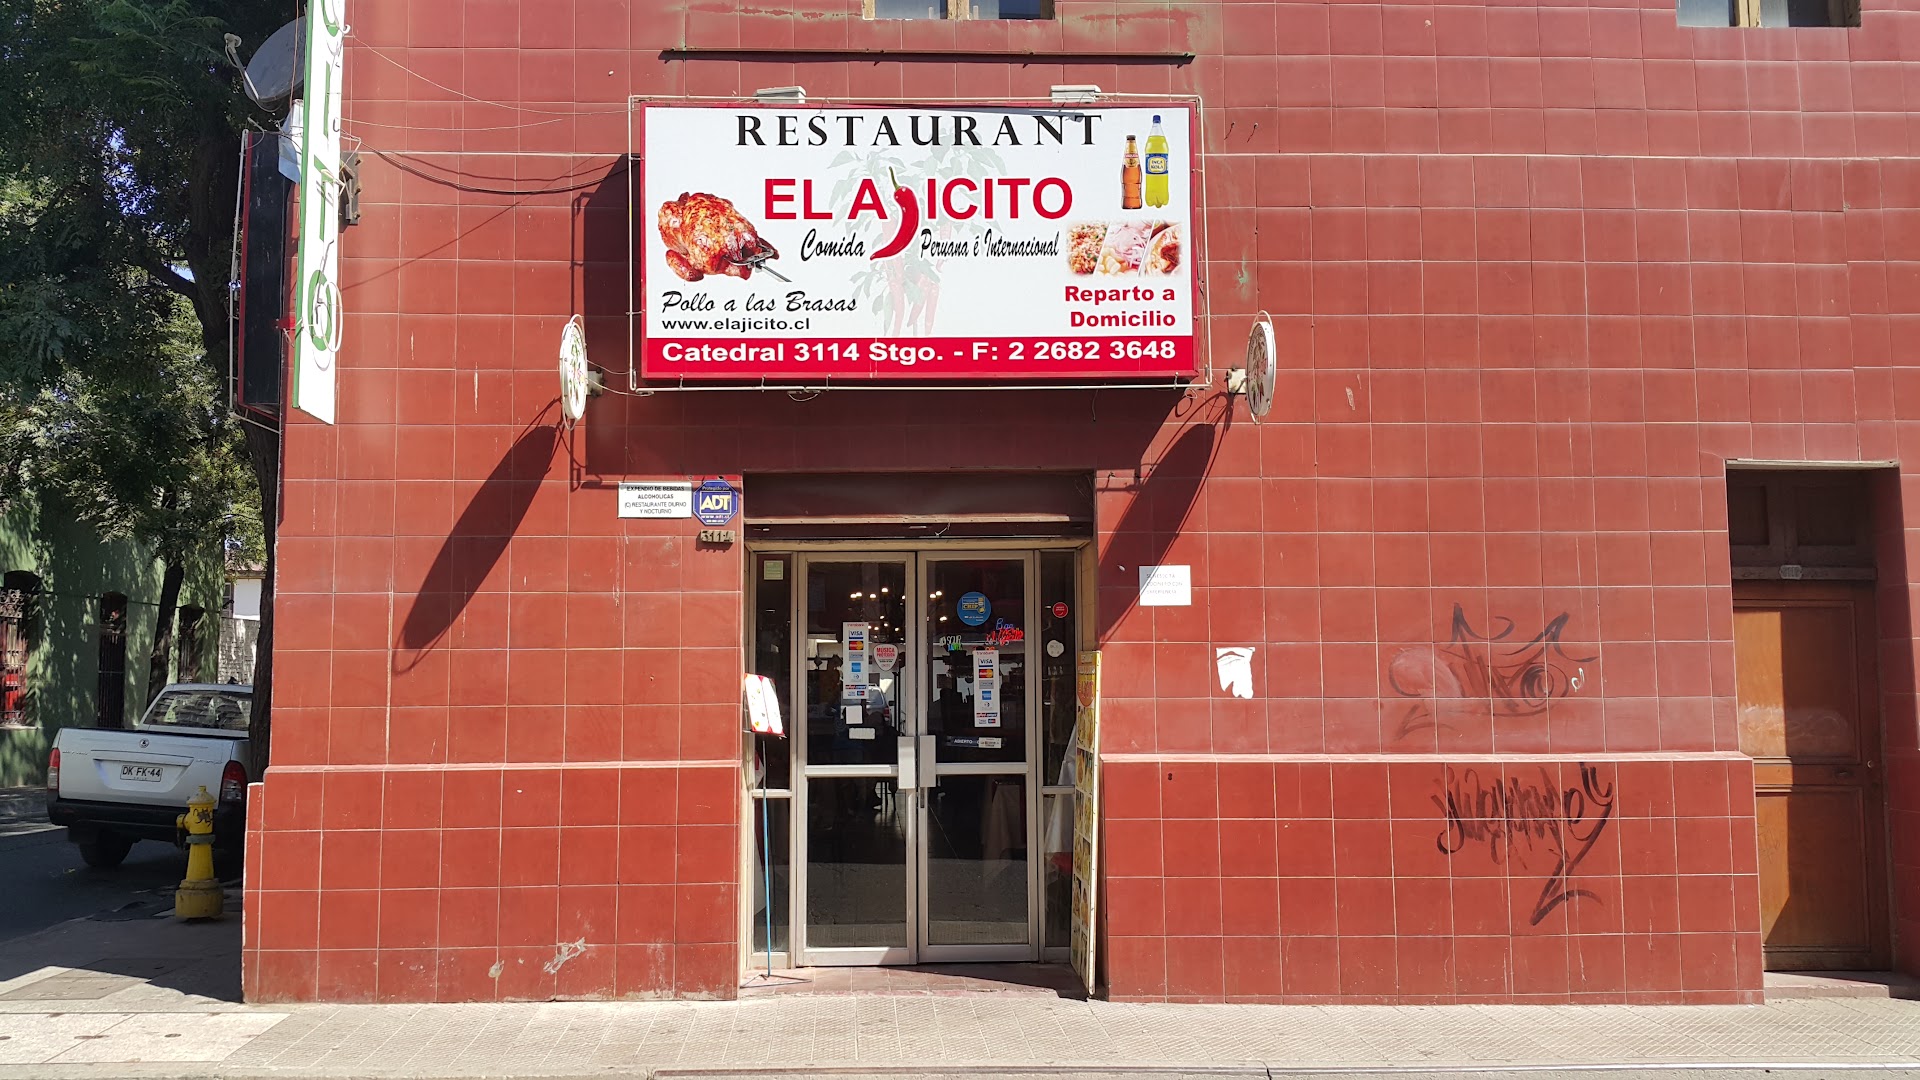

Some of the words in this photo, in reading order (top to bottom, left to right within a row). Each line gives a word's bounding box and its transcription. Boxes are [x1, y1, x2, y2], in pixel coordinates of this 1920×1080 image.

[737, 115, 1102, 146] RESTAURANT
[764, 178, 833, 220] EL
[801, 228, 866, 262] Comida
[920, 229, 969, 258] Peruana
[984, 229, 1060, 258] Internacional
[662, 290, 715, 313] Pollo
[723, 299, 737, 312] a
[745, 293, 776, 312] las
[785, 290, 857, 312] Brasas
[1065, 286, 1155, 306] Reparto
[1162, 289, 1175, 301] a
[661, 317, 810, 333] www.elajicito.cl
[1070, 311, 1176, 327] Domicilio
[662, 341, 784, 362] Catedral
[794, 342, 860, 362] 3114
[868, 341, 944, 366] Stgo.
[972, 341, 998, 361] F:
[1008, 341, 1025, 360] 2
[1032, 340, 1100, 360] 2682
[1109, 340, 1176, 360] 3648
[701, 495, 730, 511] ADT
[701, 531, 734, 542] 3114
[122, 766, 134, 776] DK
